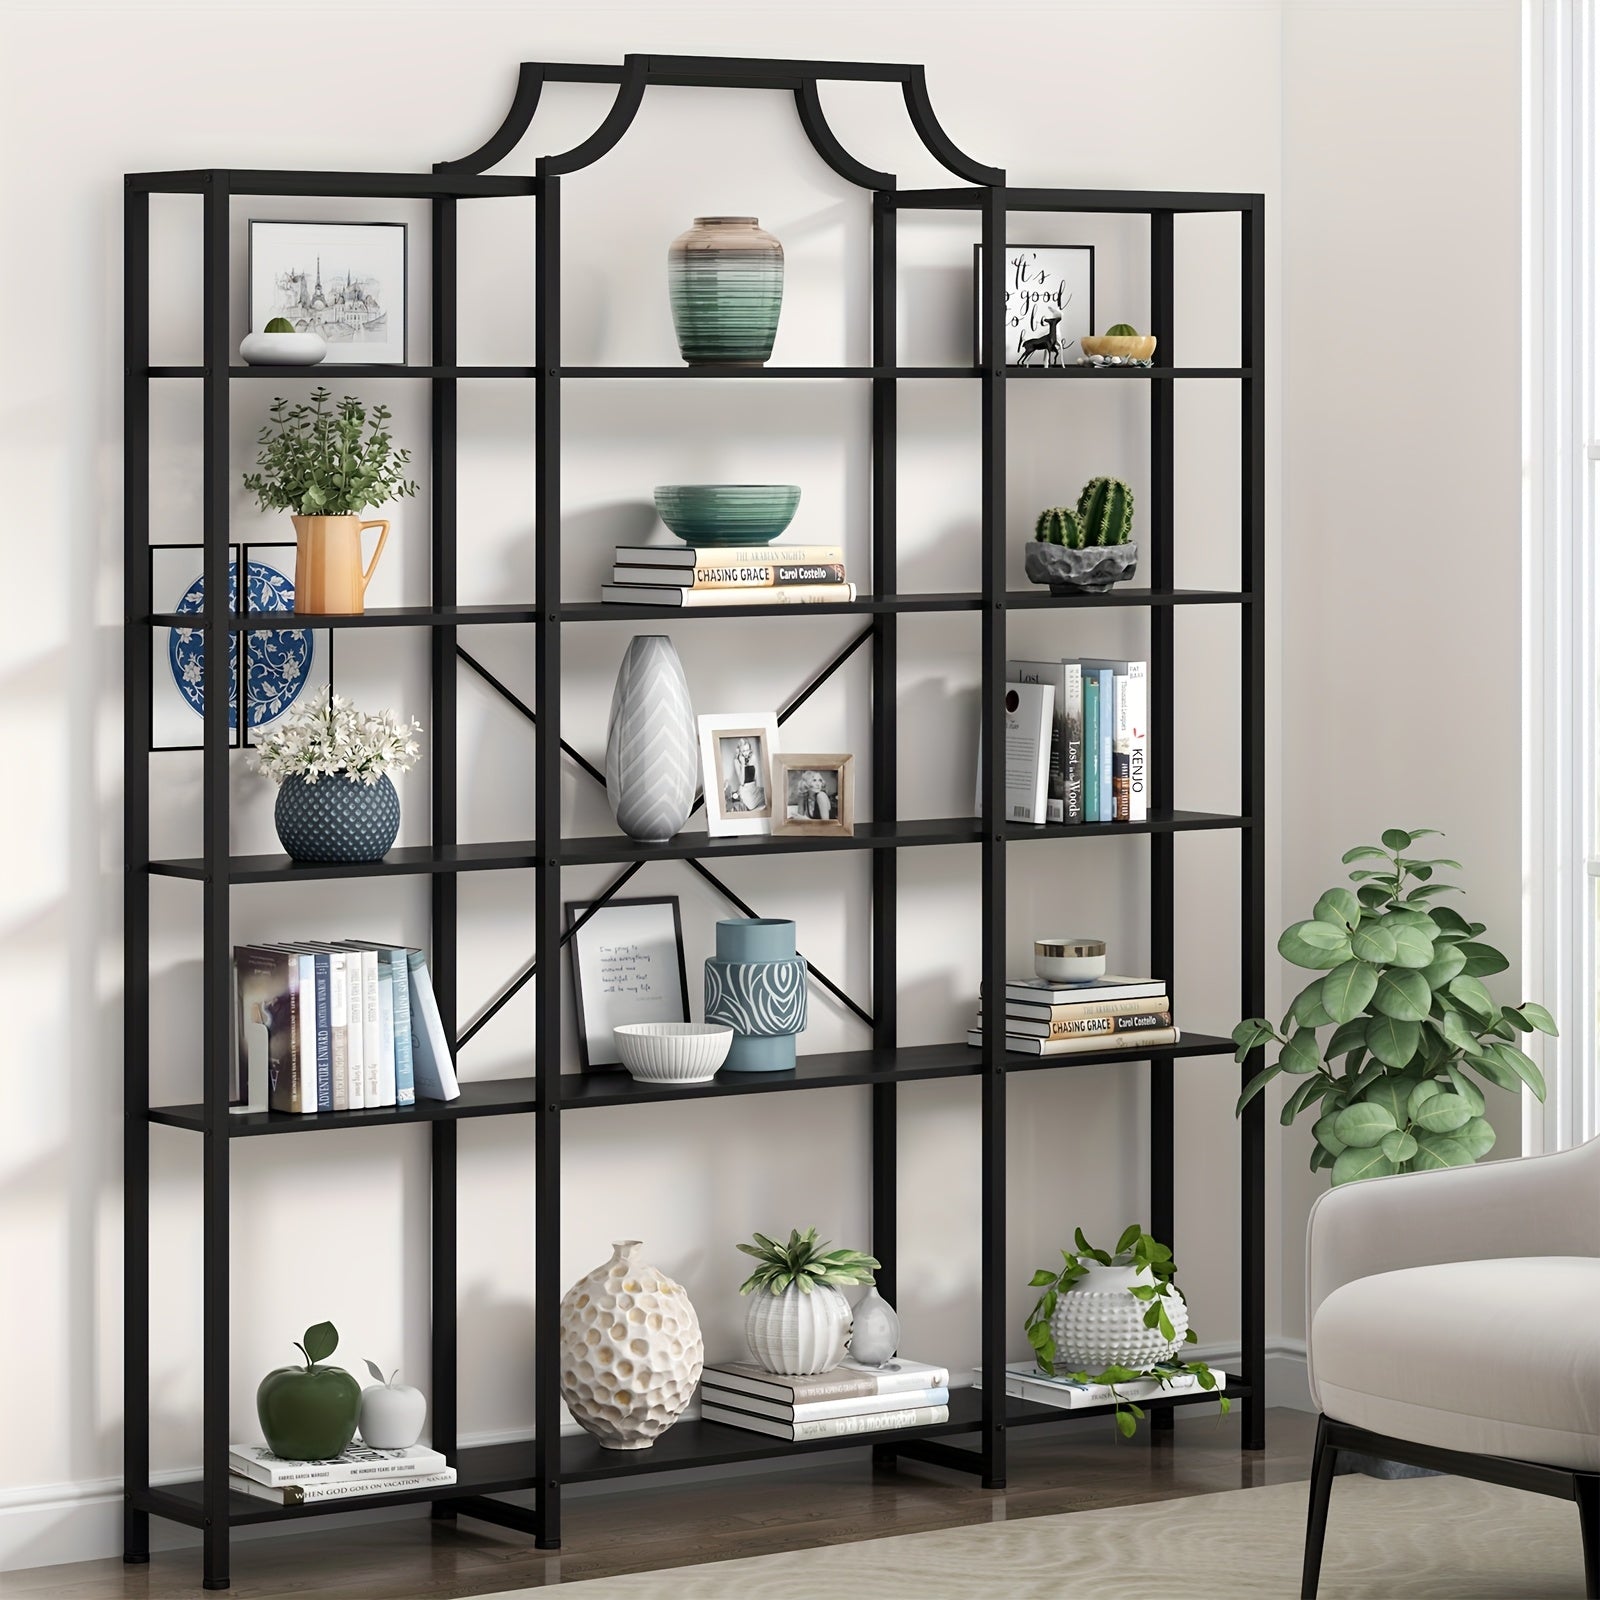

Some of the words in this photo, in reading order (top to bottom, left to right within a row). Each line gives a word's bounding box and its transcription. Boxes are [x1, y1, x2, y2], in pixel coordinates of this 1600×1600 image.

[1011, 253, 1051, 290] It's
[1020, 279, 1072, 316] good
[697, 568, 738, 582] CHASING
[740, 567, 770, 581] GRACE
[779, 567, 798, 580] Carol
[799, 567, 827, 579] Costello
[1068, 741, 1080, 764] Lost
[1132, 748, 1144, 793] KENJO
[1068, 780, 1081, 817] Woods
[392, 960, 408, 993] sebold
[393, 994, 409, 1018] alice
[1052, 1021, 1086, 1034] CHASING
[1086, 1018, 1111, 1031] GRACE
[1118, 1017, 1133, 1028] Carol
[1134, 1015, 1157, 1027] Costello
[317, 1030, 329, 1061] INWARD
[318, 1062, 330, 1107] ADVENTURE
[836, 1421, 845, 1433] to
[858, 1418, 866, 1431] a
[866, 1409, 917, 1429] mockingbird
[294, 1489, 324, 1500] WHEN
[326, 1486, 349, 1497] GOD
[349, 1483, 369, 1493] GOES
[370, 1482, 382, 1491] ON
[383, 1478, 420, 1489] VACATION
